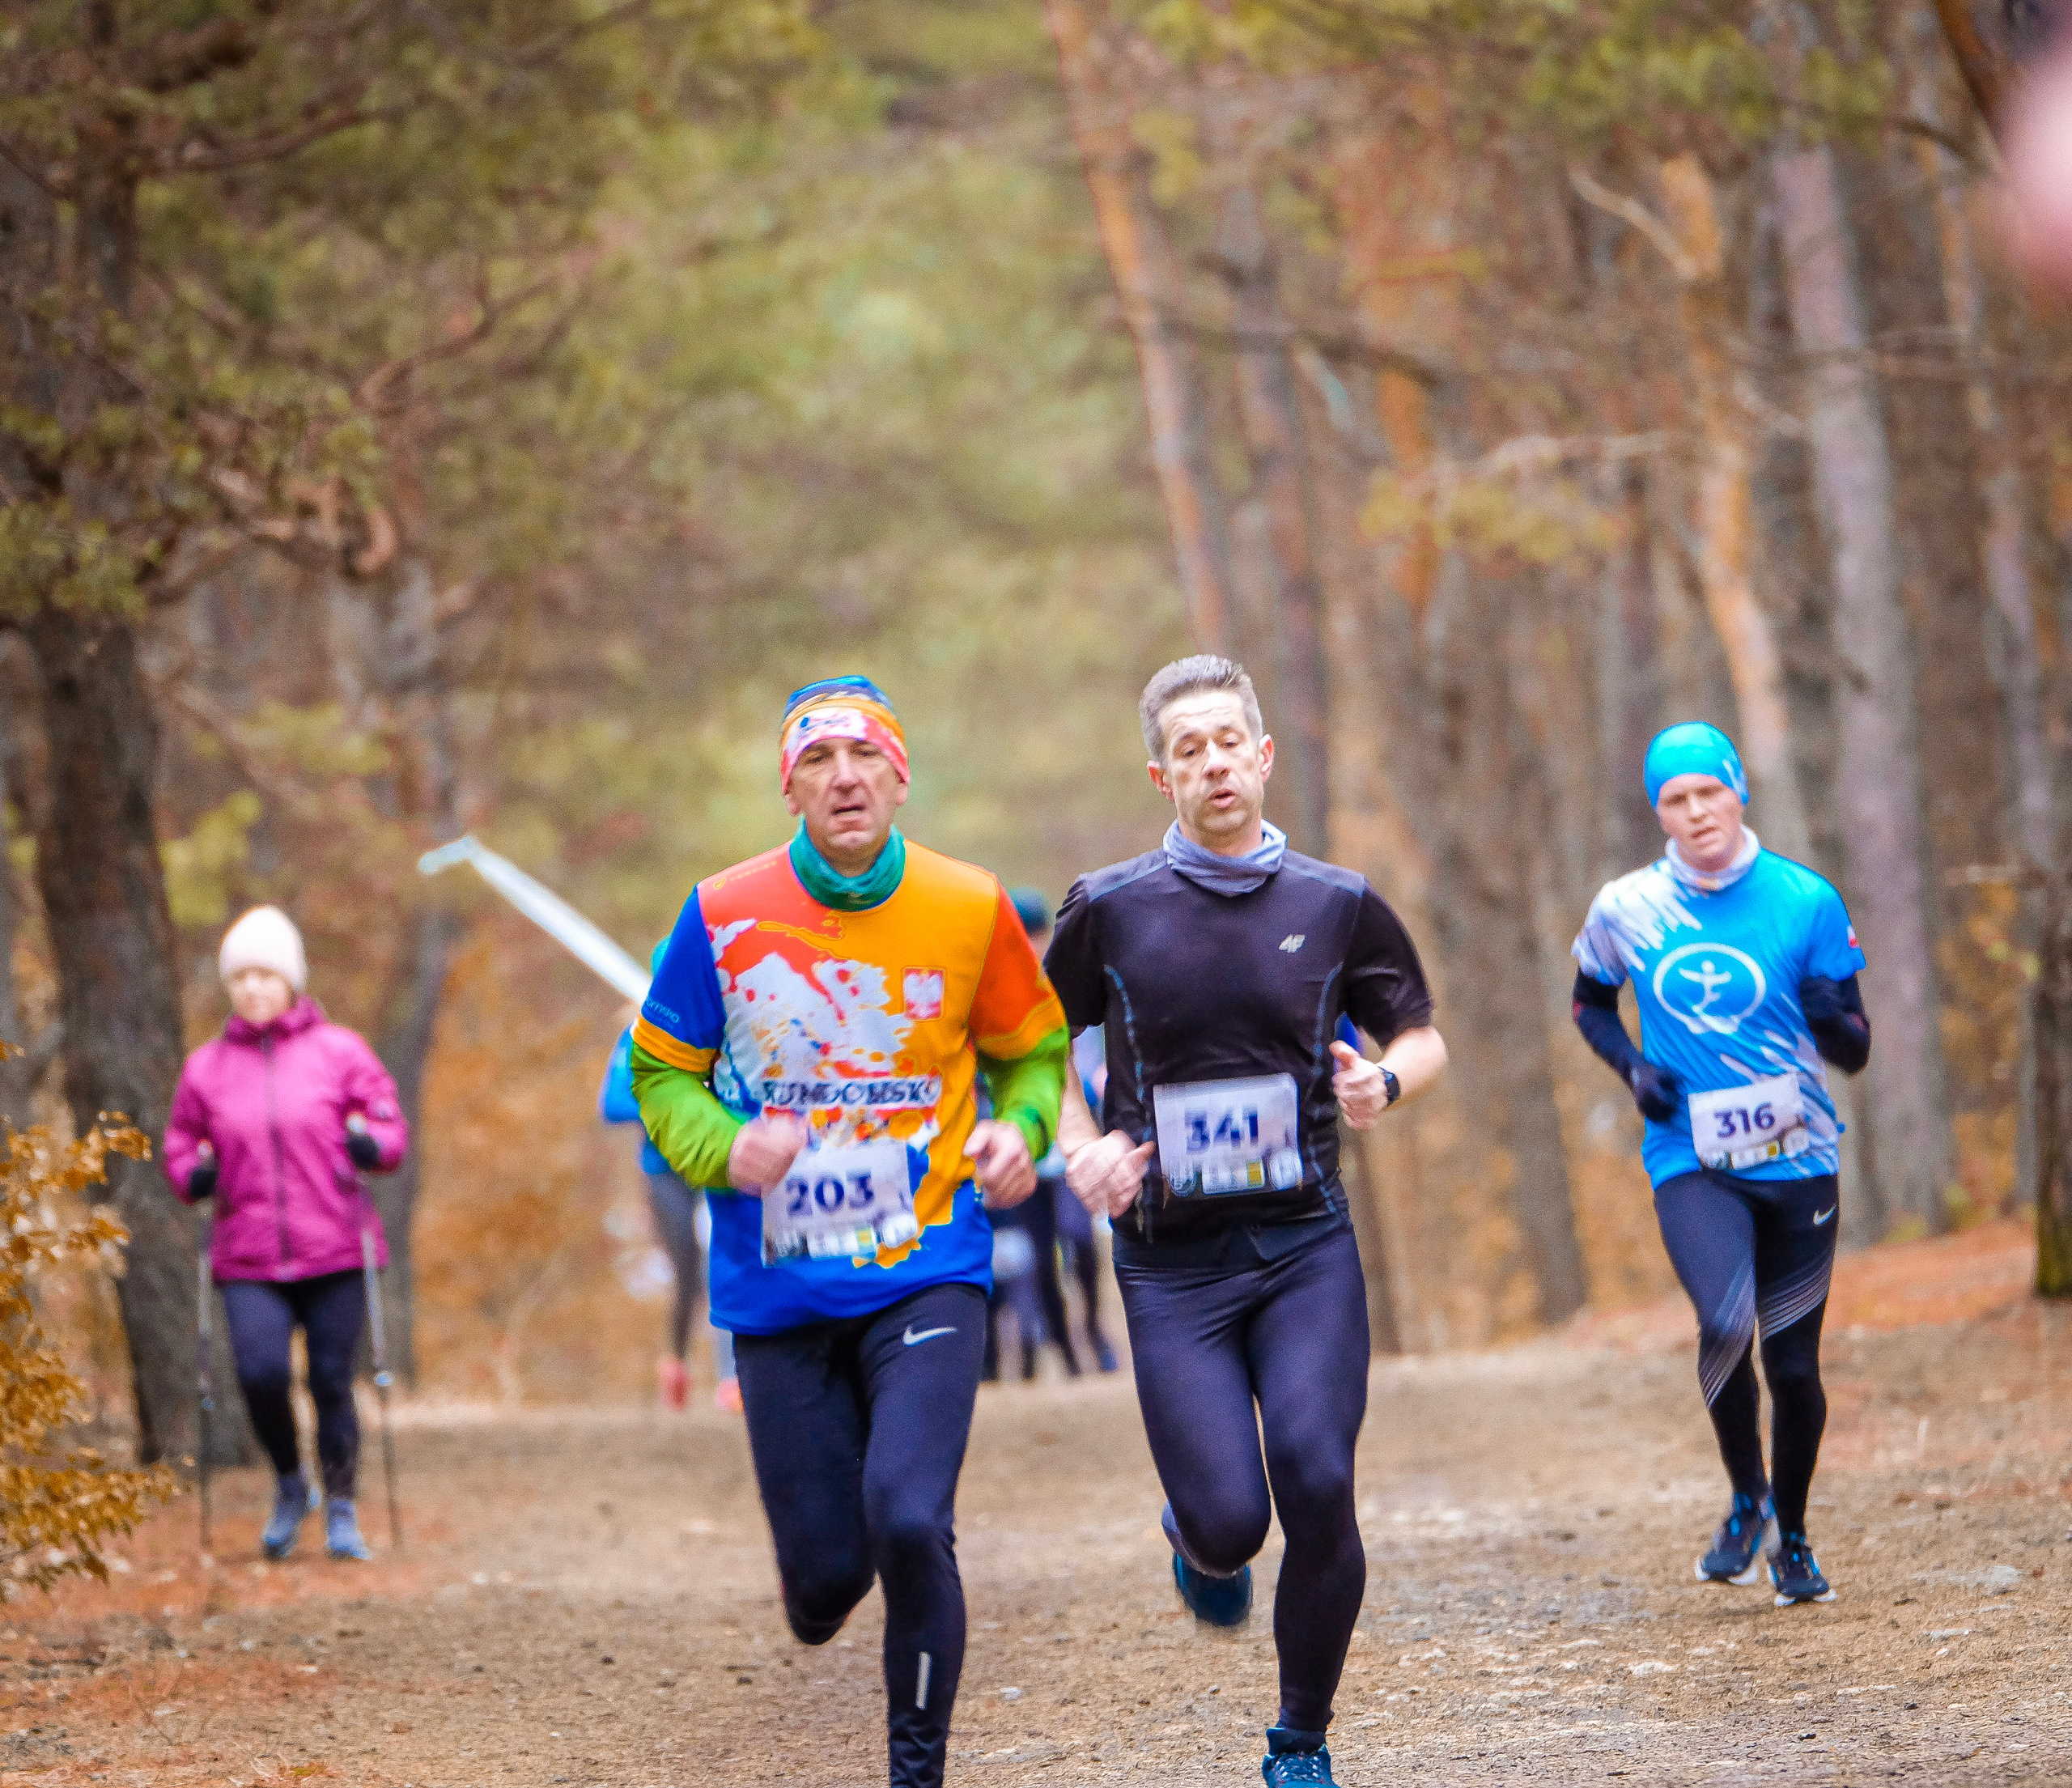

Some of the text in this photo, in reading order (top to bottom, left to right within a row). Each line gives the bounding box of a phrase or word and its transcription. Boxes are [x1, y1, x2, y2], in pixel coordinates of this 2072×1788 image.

[1183, 1108, 1259, 1154] 341
[1713, 1102, 1776, 1139] 316
[786, 1170, 874, 1217] 203
